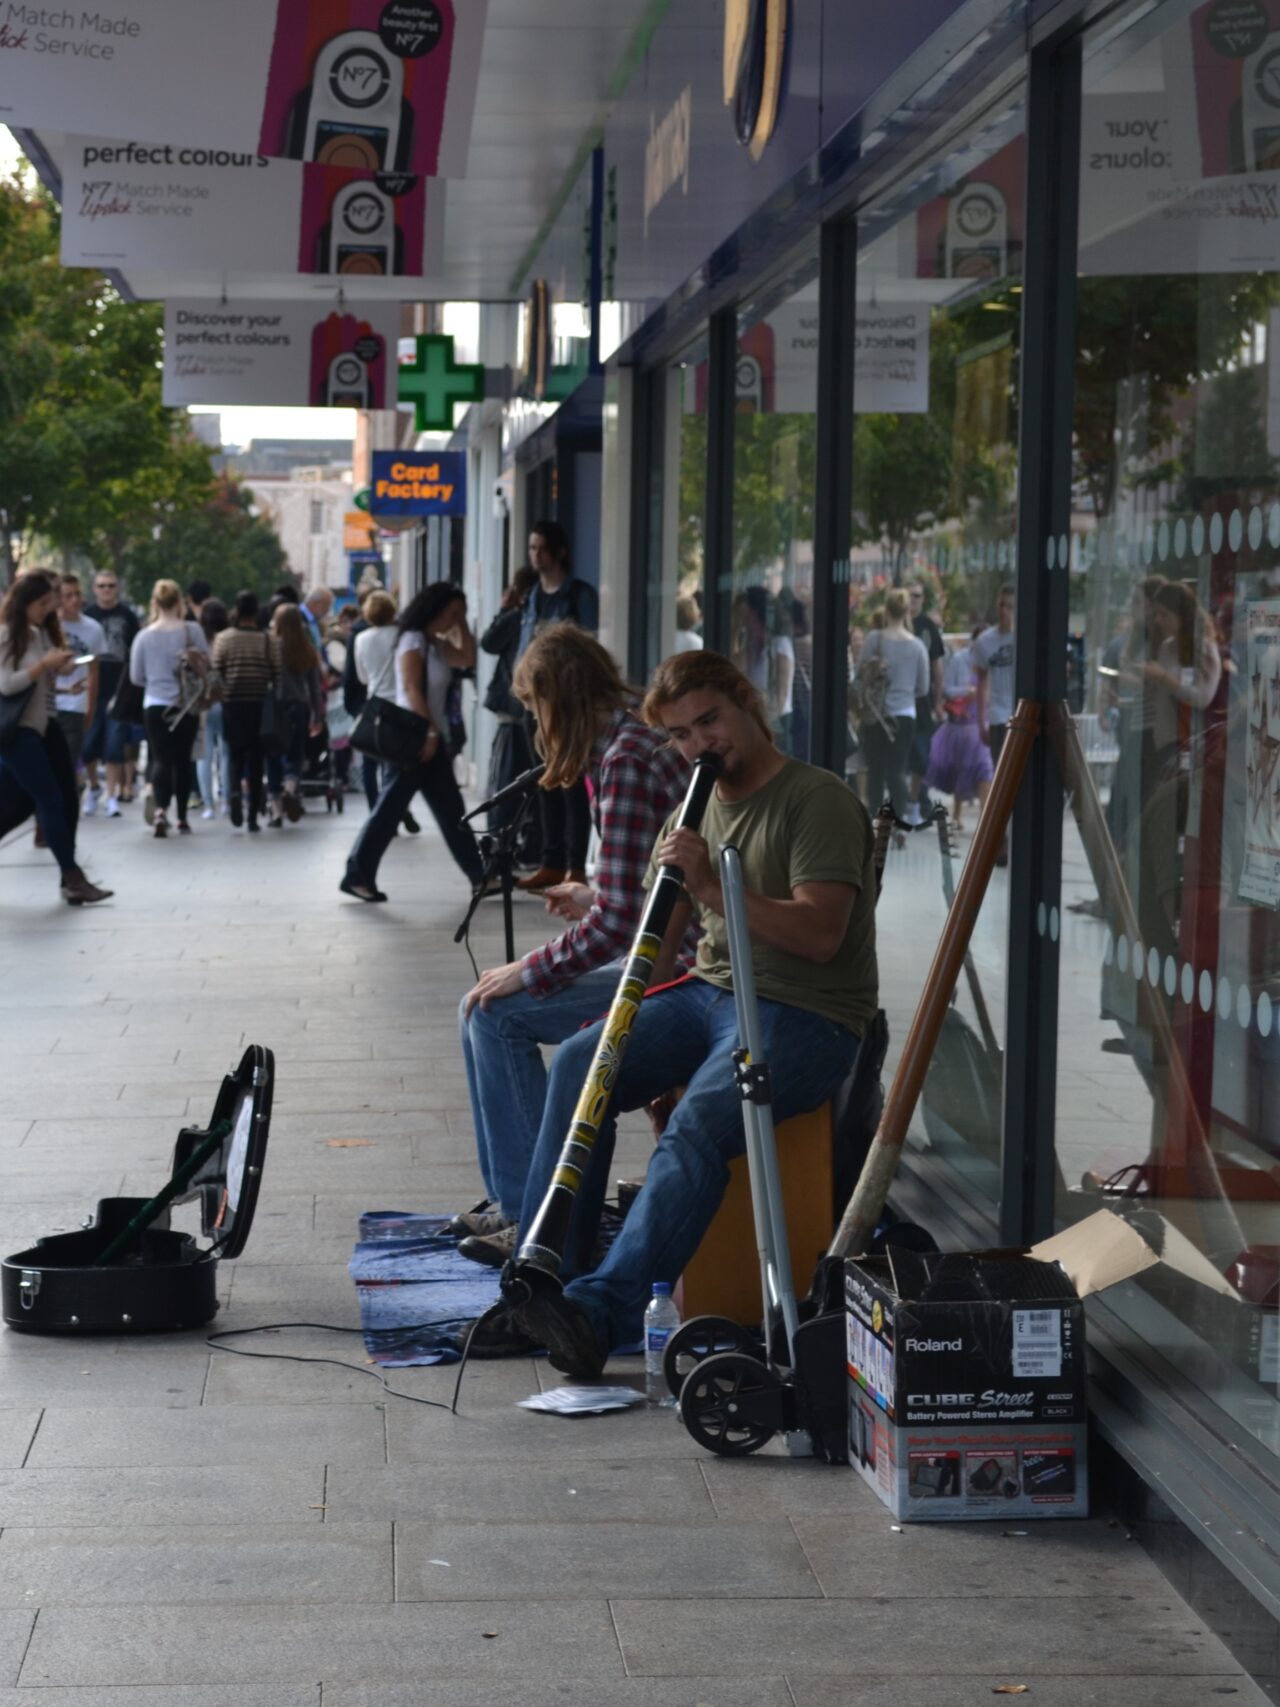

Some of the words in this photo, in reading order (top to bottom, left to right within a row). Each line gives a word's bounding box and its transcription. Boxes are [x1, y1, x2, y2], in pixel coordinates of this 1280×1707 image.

[392, 4, 433, 18] Another
[6, 3, 75, 29] Match
[80, 12, 141, 37] Made
[382, 17, 417, 32] beauty
[419, 21, 439, 32] first
[33, 32, 115, 60] Service
[83, 142, 174, 167] perfect
[115, 182, 165, 198] Match
[168, 183, 210, 199] Made
[136, 201, 193, 217] Service
[176, 310, 243, 326] Discover
[247, 315, 283, 330] your
[176, 330, 231, 346] perfect
[235, 331, 291, 346] colours
[390, 463, 440, 481] Card
[376, 480, 454, 501] Factory
[905, 1338, 962, 1352] Roland
[907, 1393, 975, 1407] CUBE
[977, 1389, 1034, 1408] Street
[907, 1411, 935, 1421] Battery
[937, 1411, 971, 1420] Powered
[972, 1410, 997, 1419] Stereo
[999, 1409, 1034, 1419] Amplifier
